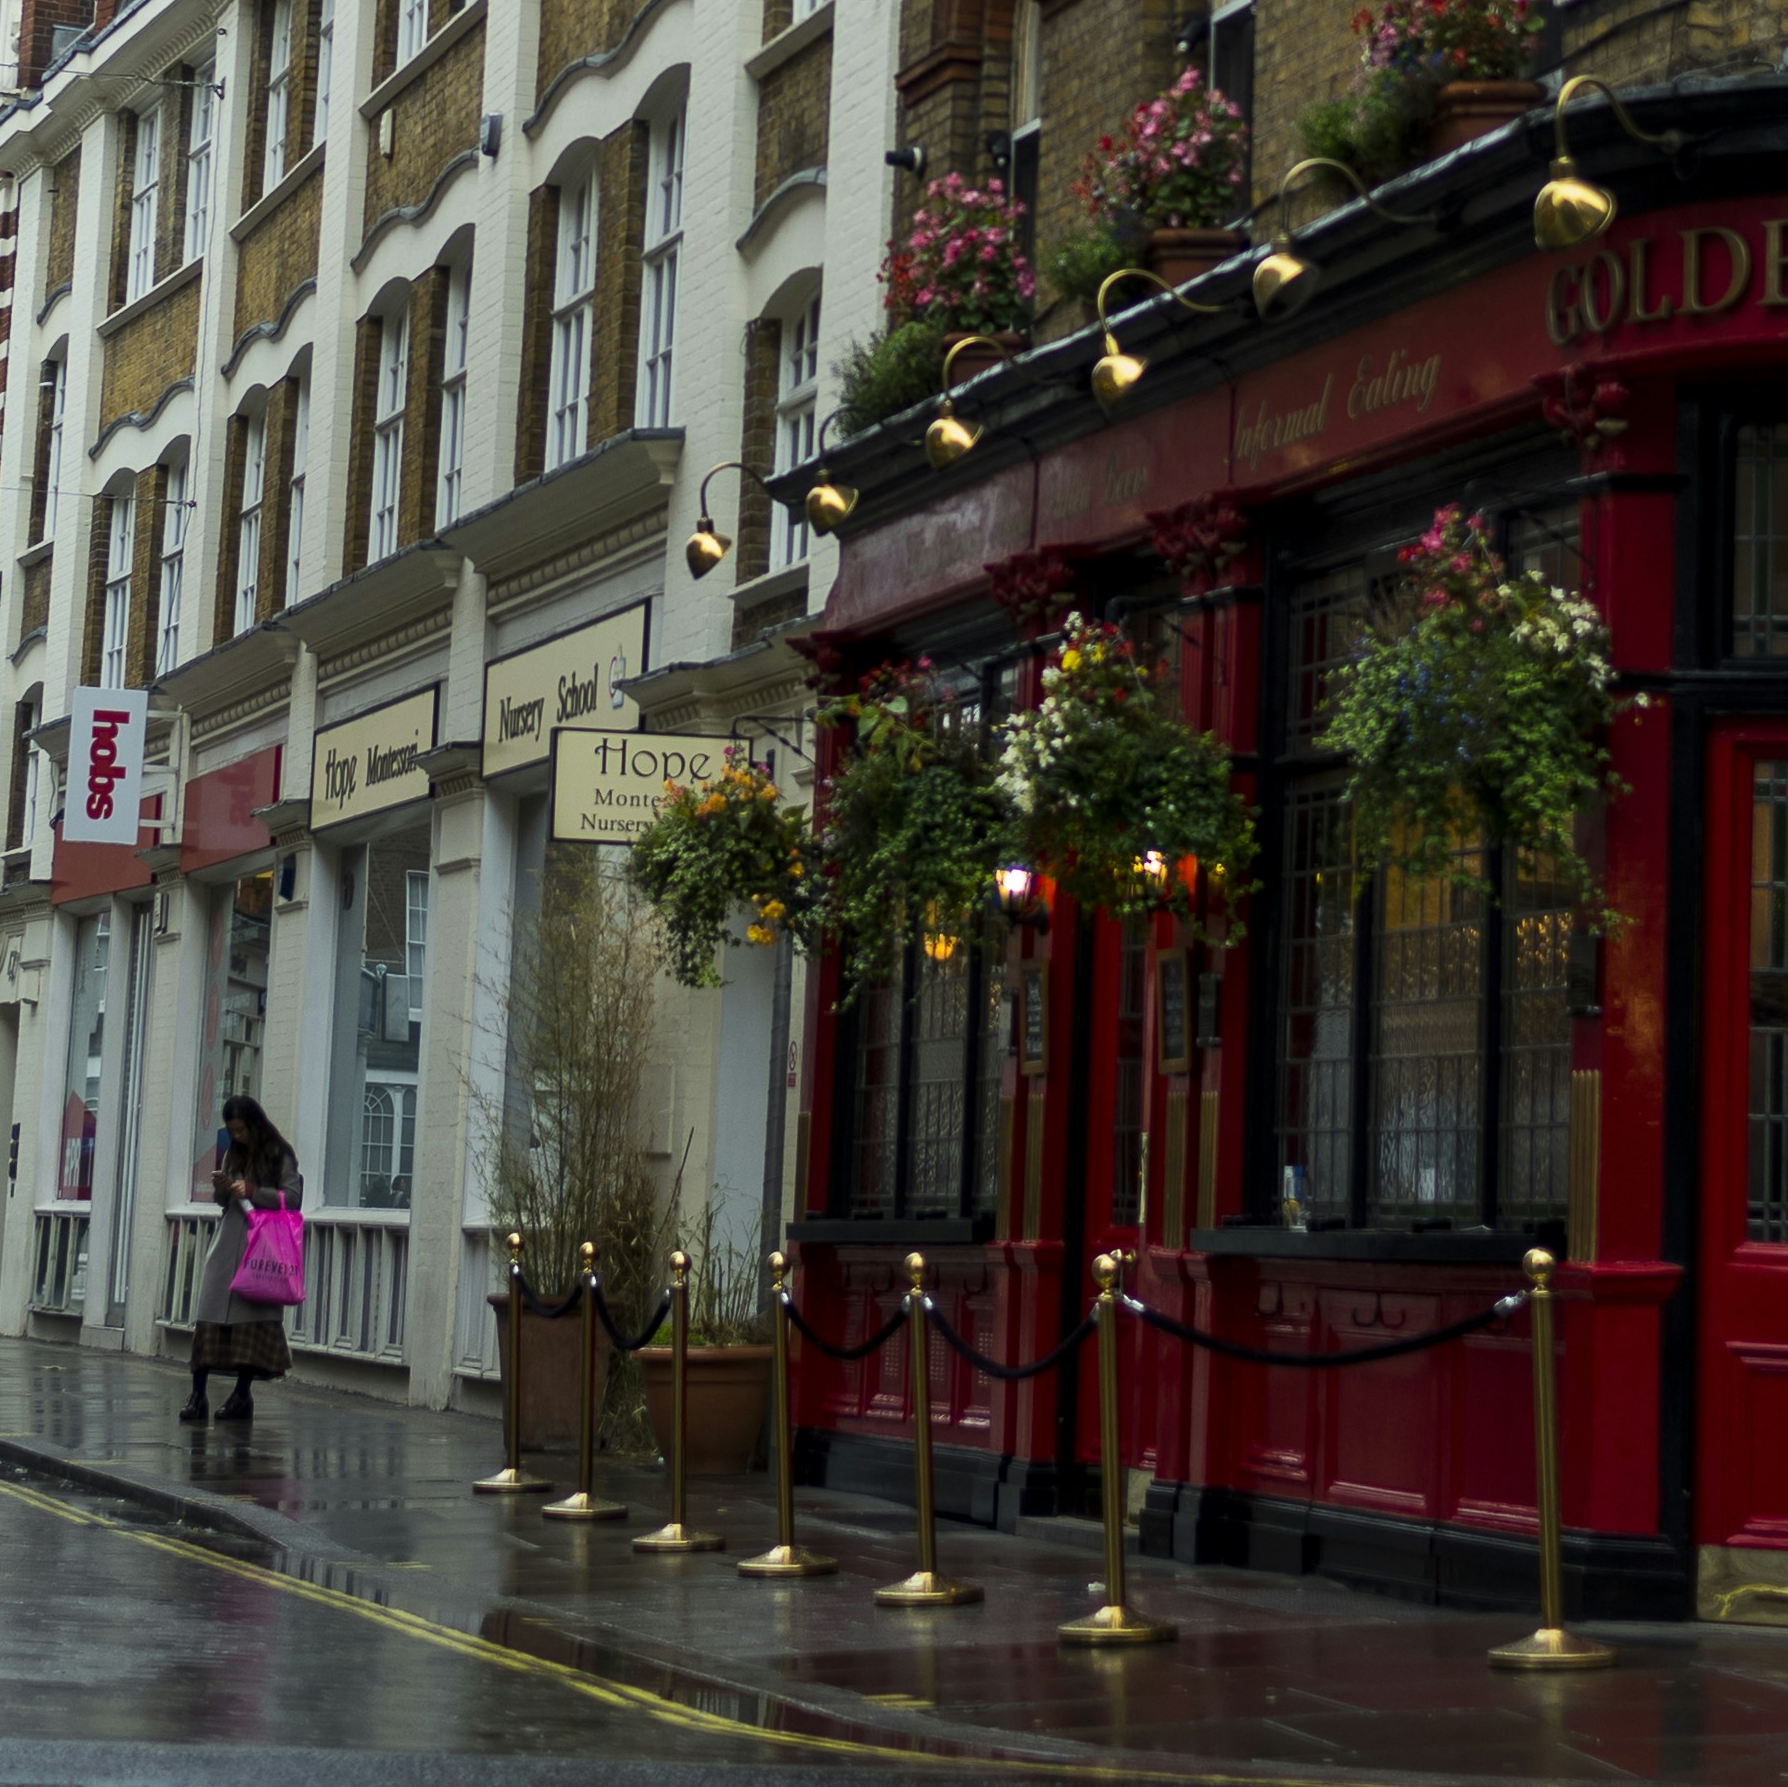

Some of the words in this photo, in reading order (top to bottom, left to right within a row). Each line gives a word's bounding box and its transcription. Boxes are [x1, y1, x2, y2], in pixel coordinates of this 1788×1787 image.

[1232, 373, 1332, 472] Informal
[1348, 349, 1442, 422] Eating
[498, 696, 545, 743] Nursery
[556, 662, 599, 723] School
[86, 709, 130, 820] hobs
[325, 748, 358, 810] Hope
[594, 738, 712, 784] Hope
[594, 788, 662, 808] Monte
